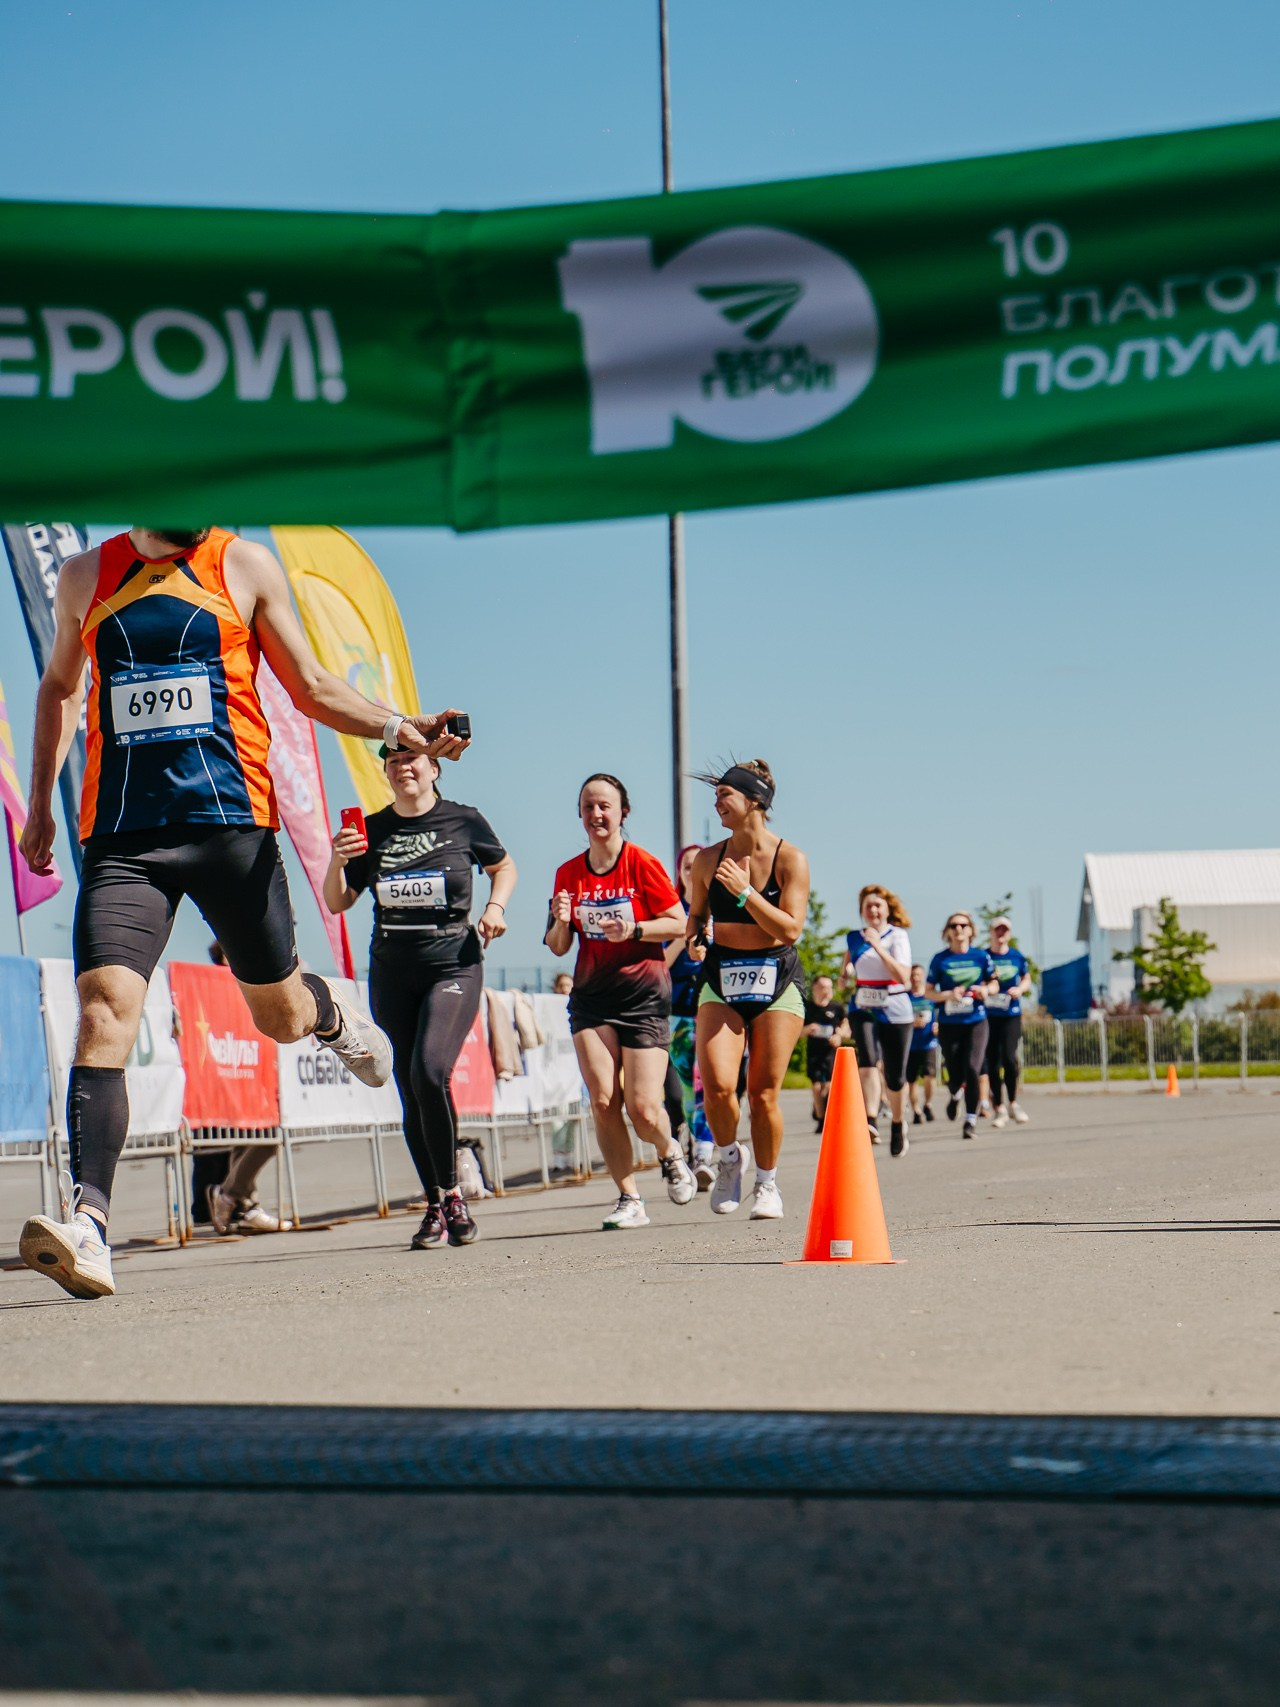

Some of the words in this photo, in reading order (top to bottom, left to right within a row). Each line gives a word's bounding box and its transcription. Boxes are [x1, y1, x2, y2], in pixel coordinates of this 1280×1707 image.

[993, 223, 1070, 278] 10
[128, 686, 193, 717] 6990
[390, 881, 433, 899] 5403
[729, 970, 767, 987] 7996
